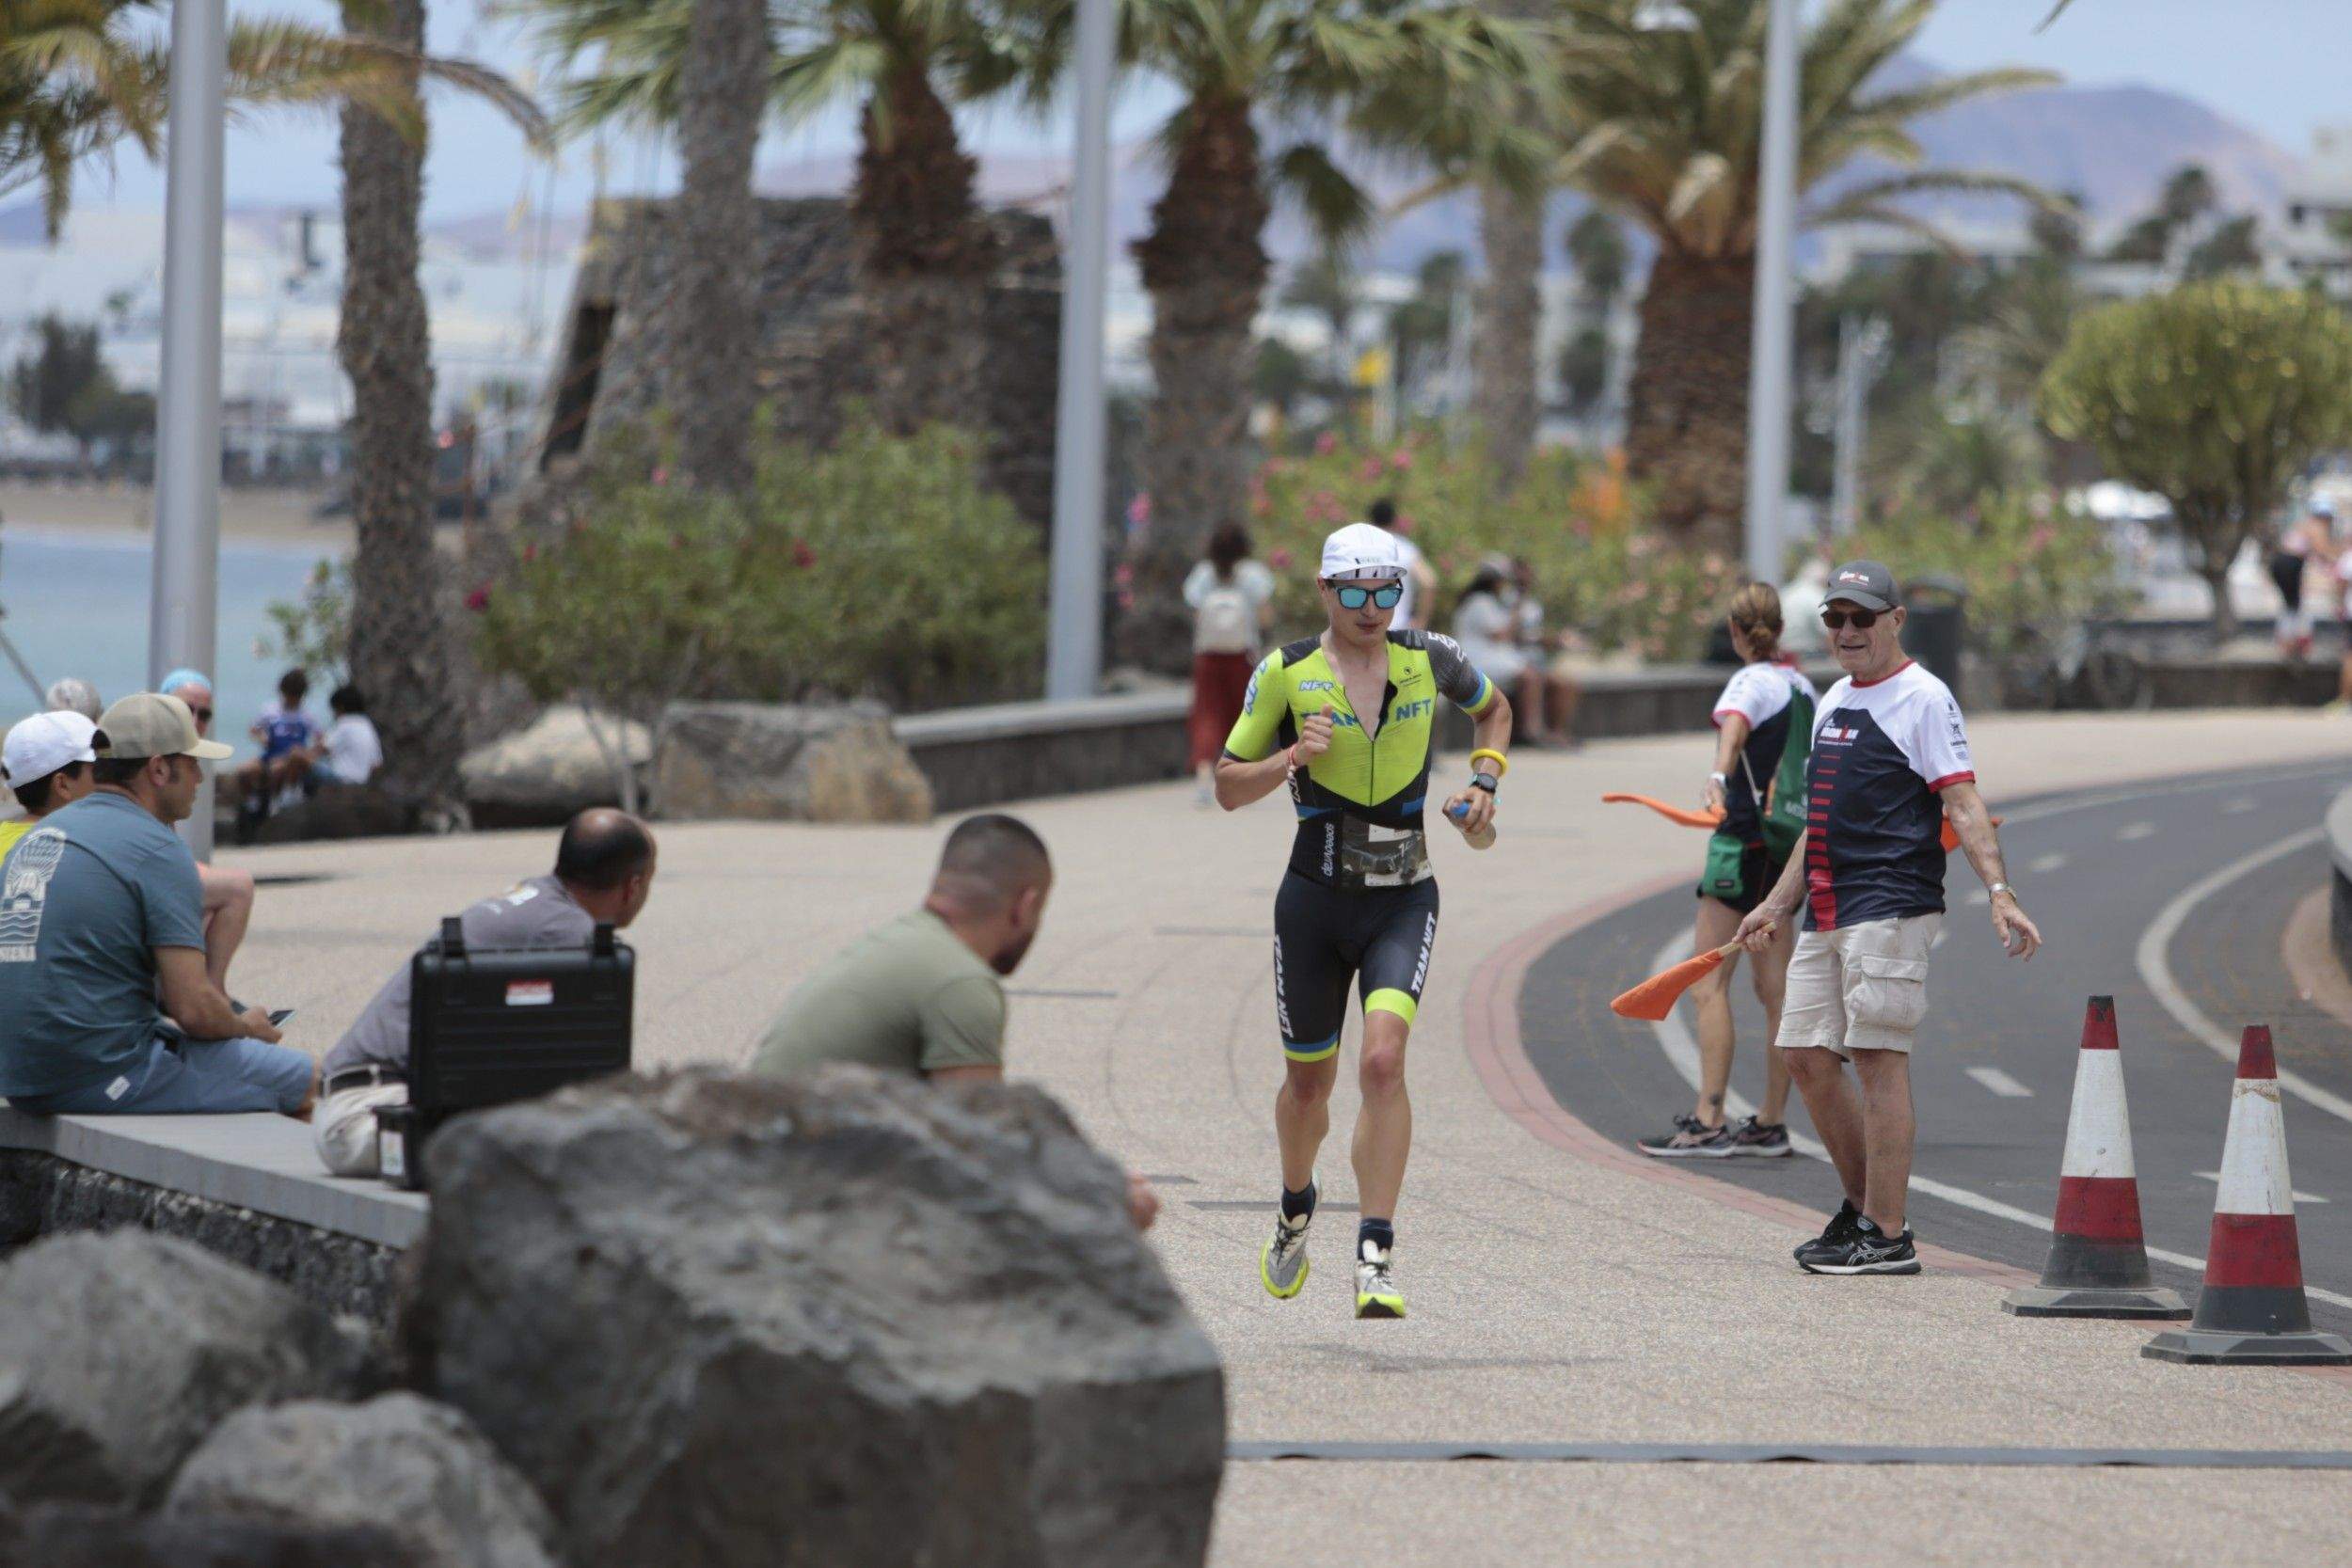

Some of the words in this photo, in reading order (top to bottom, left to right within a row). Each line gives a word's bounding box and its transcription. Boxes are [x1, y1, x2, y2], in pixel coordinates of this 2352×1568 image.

[1395, 699, 1431, 721] NFT
[1411, 944, 1430, 993] TEAM
[1422, 911, 1436, 948] NFT
